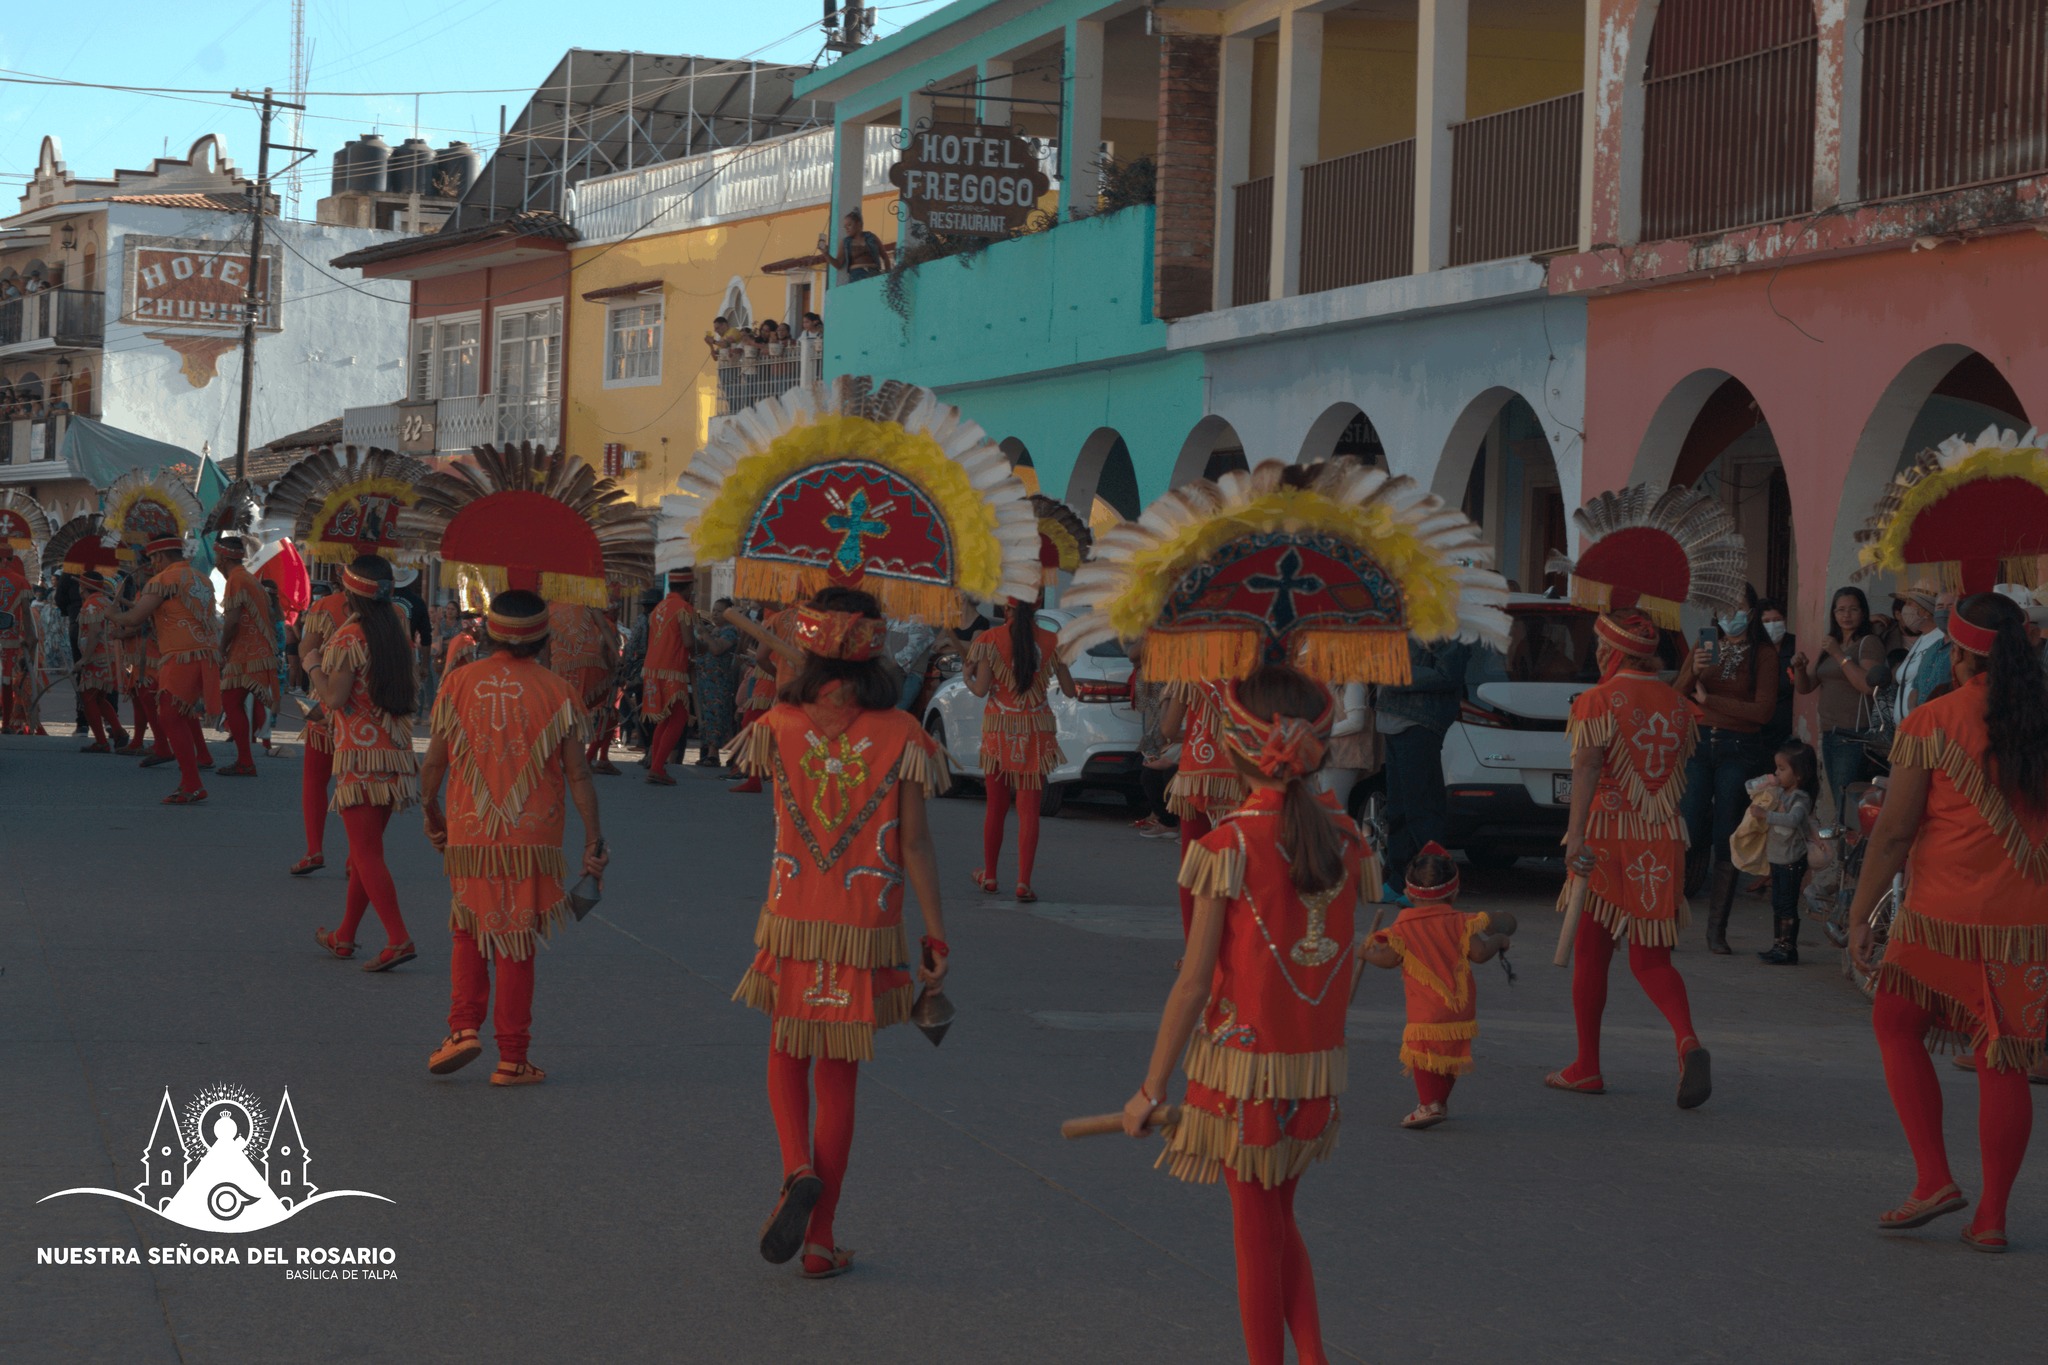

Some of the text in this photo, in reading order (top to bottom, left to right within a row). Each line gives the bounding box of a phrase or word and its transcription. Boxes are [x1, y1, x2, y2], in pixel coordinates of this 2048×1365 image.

[918, 133, 1024, 169] HOTEL
[903, 170, 1035, 207] FREGOSO
[928, 211, 1006, 232] RESTAURANT
[403, 415, 423, 441] 22
